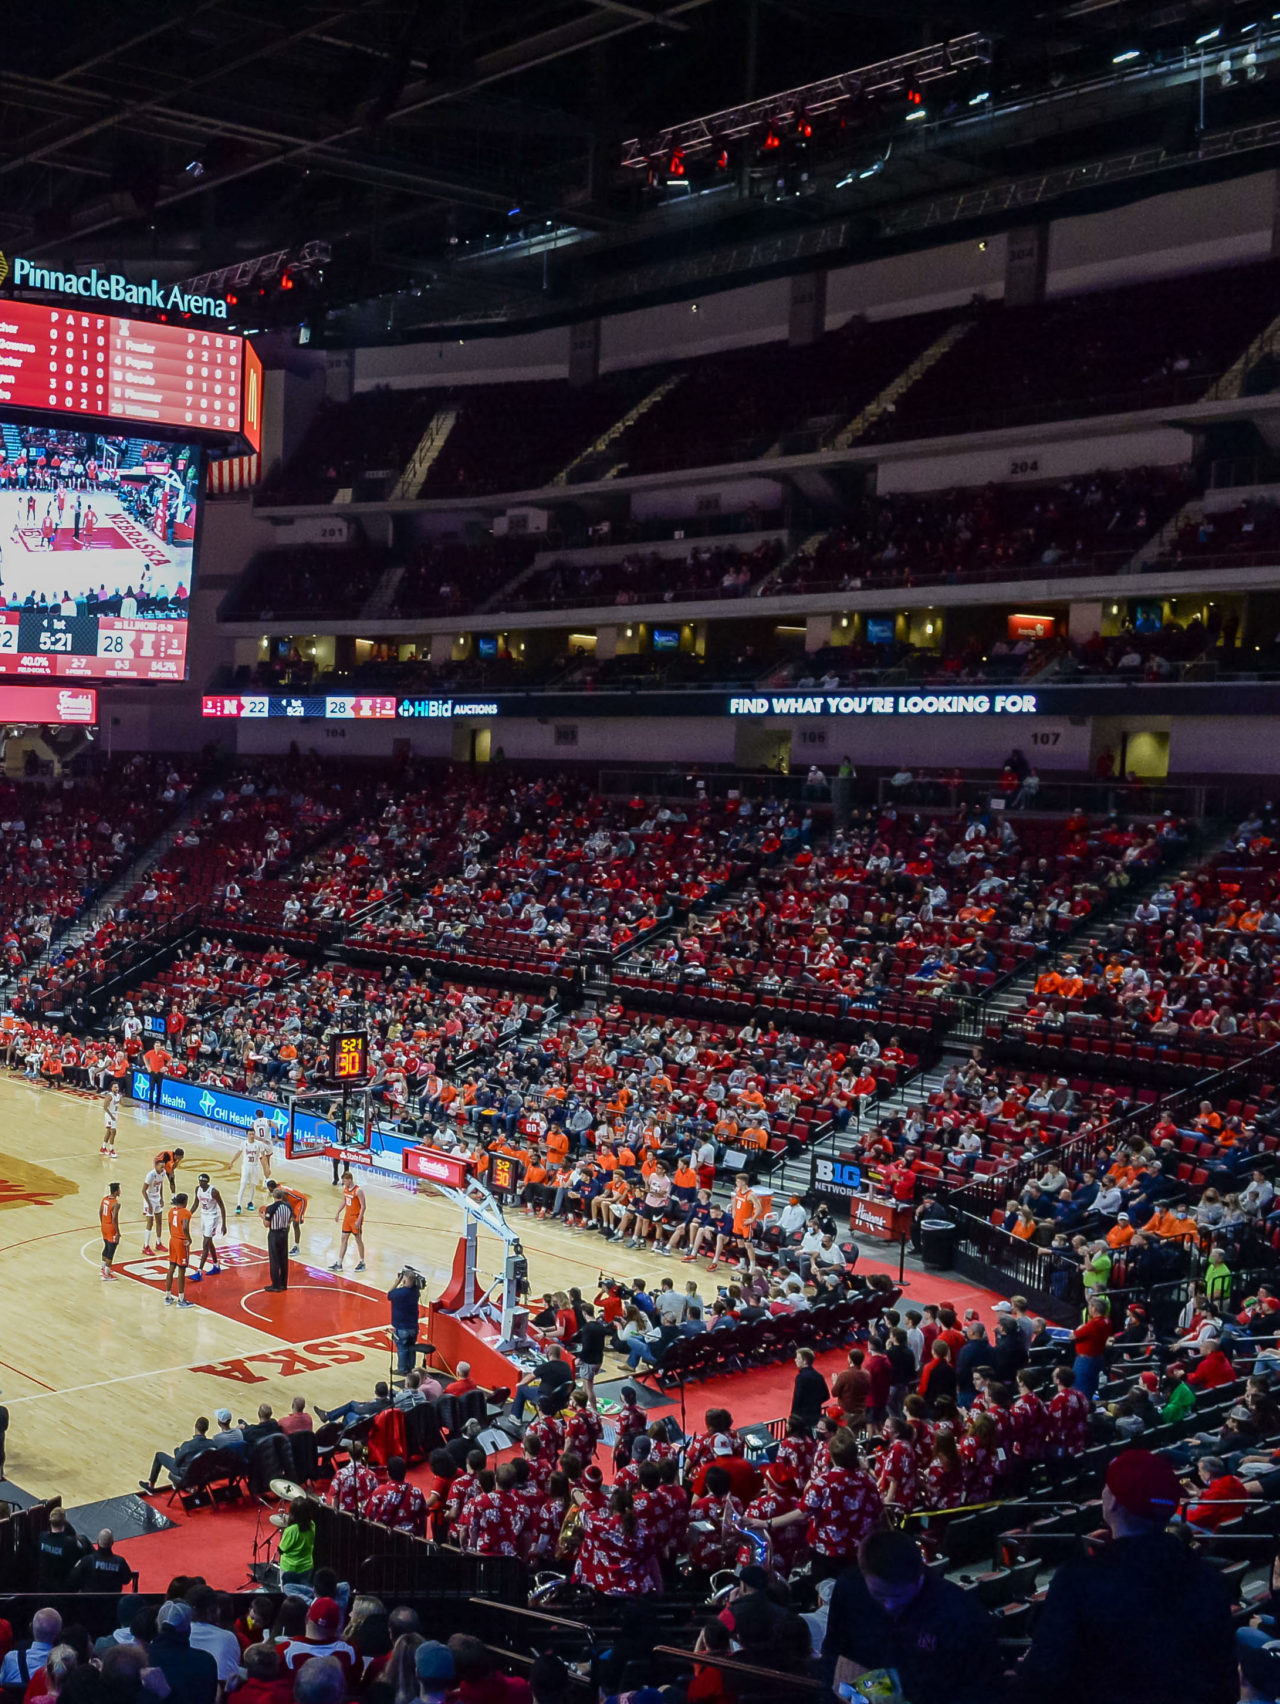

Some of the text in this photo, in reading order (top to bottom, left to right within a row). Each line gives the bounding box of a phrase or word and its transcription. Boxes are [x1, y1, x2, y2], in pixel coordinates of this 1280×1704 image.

[167, 286, 227, 318] Arena
[51, 312, 104, 329] P A R F
[50, 329, 57, 339] 0
[66, 332, 74, 341] 0
[83, 334, 87, 343] 1
[188, 333, 195, 343] P
[202, 336, 209, 346] A
[230, 340, 236, 349] F
[50, 346, 57, 355] 7
[66, 348, 73, 358] 0
[83, 350, 87, 360] 1
[202, 351, 208, 361] 2
[217, 354, 221, 363] 1
[50, 362, 57, 372] 0
[230, 371, 235, 381] 1
[50, 379, 56, 388] 3
[65, 381, 73, 391] 0
[81, 383, 87, 392] 3
[203, 383, 207, 392] 1
[49, 395, 57, 405] 0
[65, 397, 72, 407] 0
[80, 399, 87, 409] 2
[97, 401, 102, 411] 1
[186, 397, 192, 406] 7
[214, 416, 220, 426] 2
[1010, 461, 1039, 475] 204
[106, 512, 171, 566] NEBRASKA
[321, 528, 344, 537] 201
[39, 632, 72, 651] 5:21
[104, 636, 123, 652] 28
[224, 700, 238, 714] N
[249, 701, 265, 713] 22
[330, 702, 346, 714] 28
[414, 700, 497, 716] HiBid AUCTIONS
[730, 695, 1037, 714] FIND WHAT YOU'RE LOOKING FOR
[1031, 732, 1061, 746] 107
[341, 1038, 362, 1053] 5:21
[339, 1052, 360, 1075] 30
[162, 1094, 186, 1110] Health
[214, 1107, 255, 1127] CHI Health
[495, 1171, 509, 1187] 30
[172, 1215, 178, 1227] 4
[95, 1561, 119, 1572] POLICE
